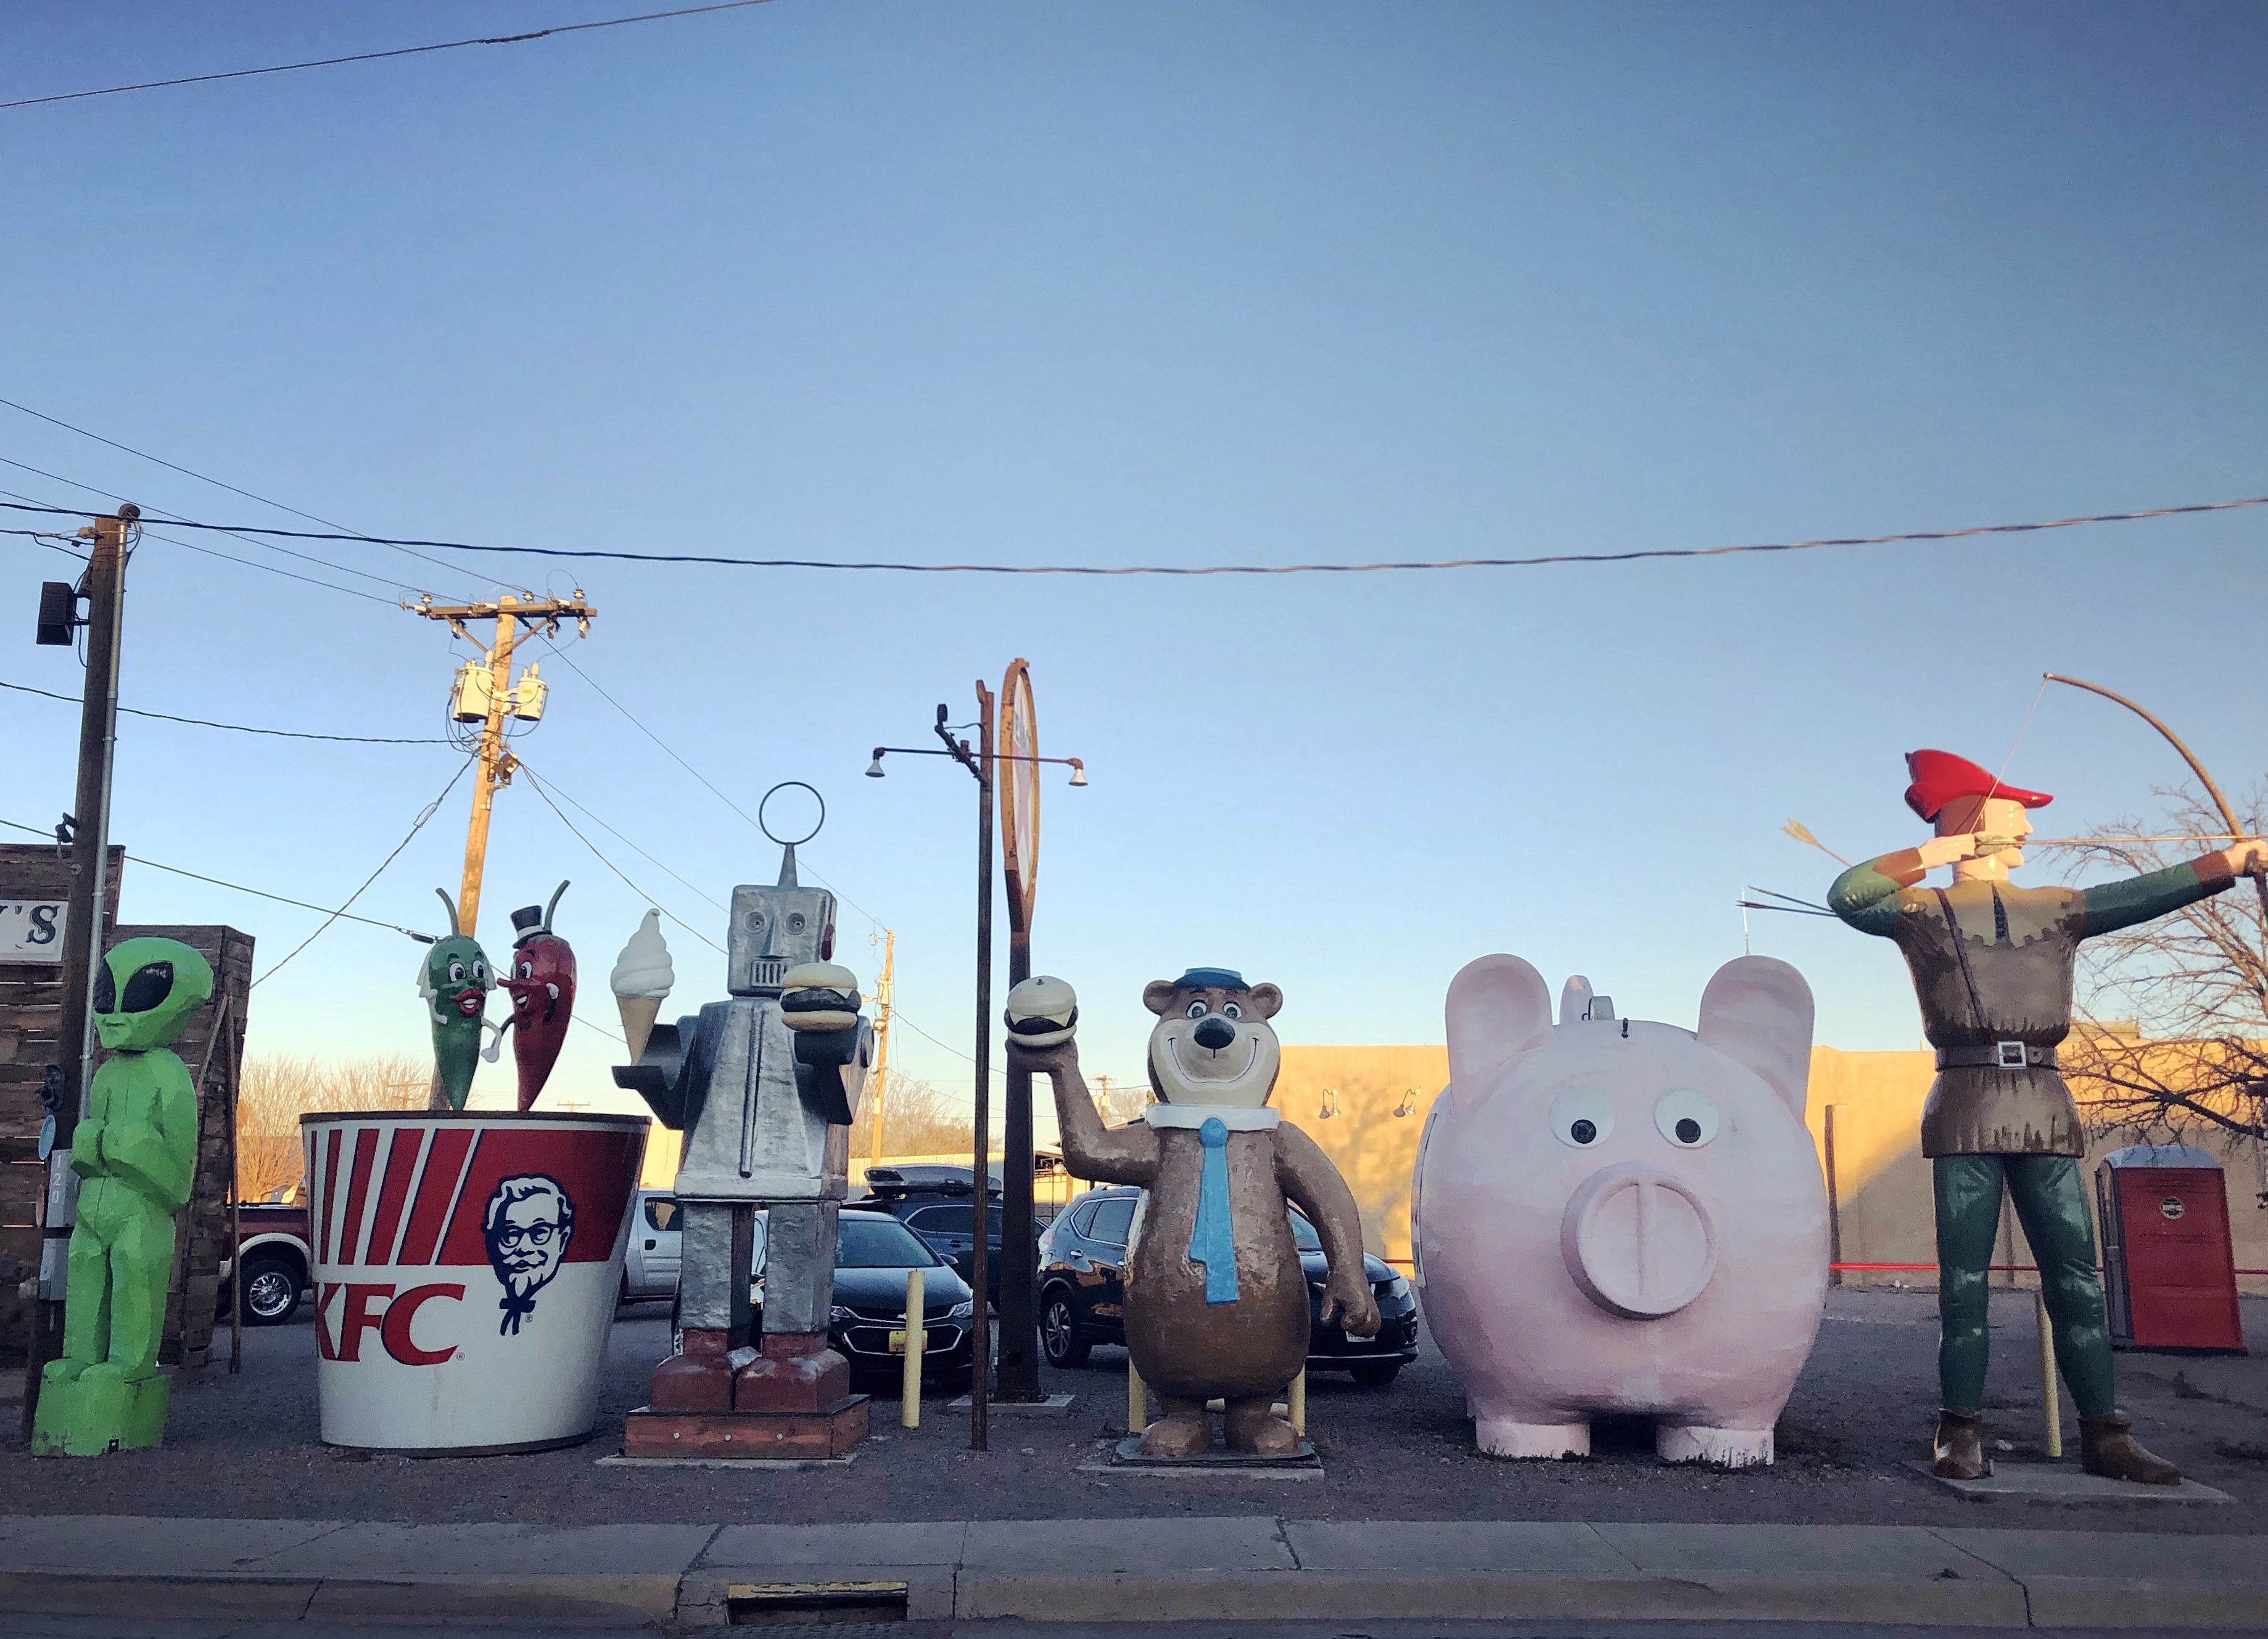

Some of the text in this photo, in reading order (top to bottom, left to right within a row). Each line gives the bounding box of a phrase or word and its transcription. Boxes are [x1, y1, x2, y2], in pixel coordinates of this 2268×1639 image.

[0, 905, 60, 944] 'S
[52, 1154, 61, 1203] 120
[313, 1282, 466, 1366] KFC
